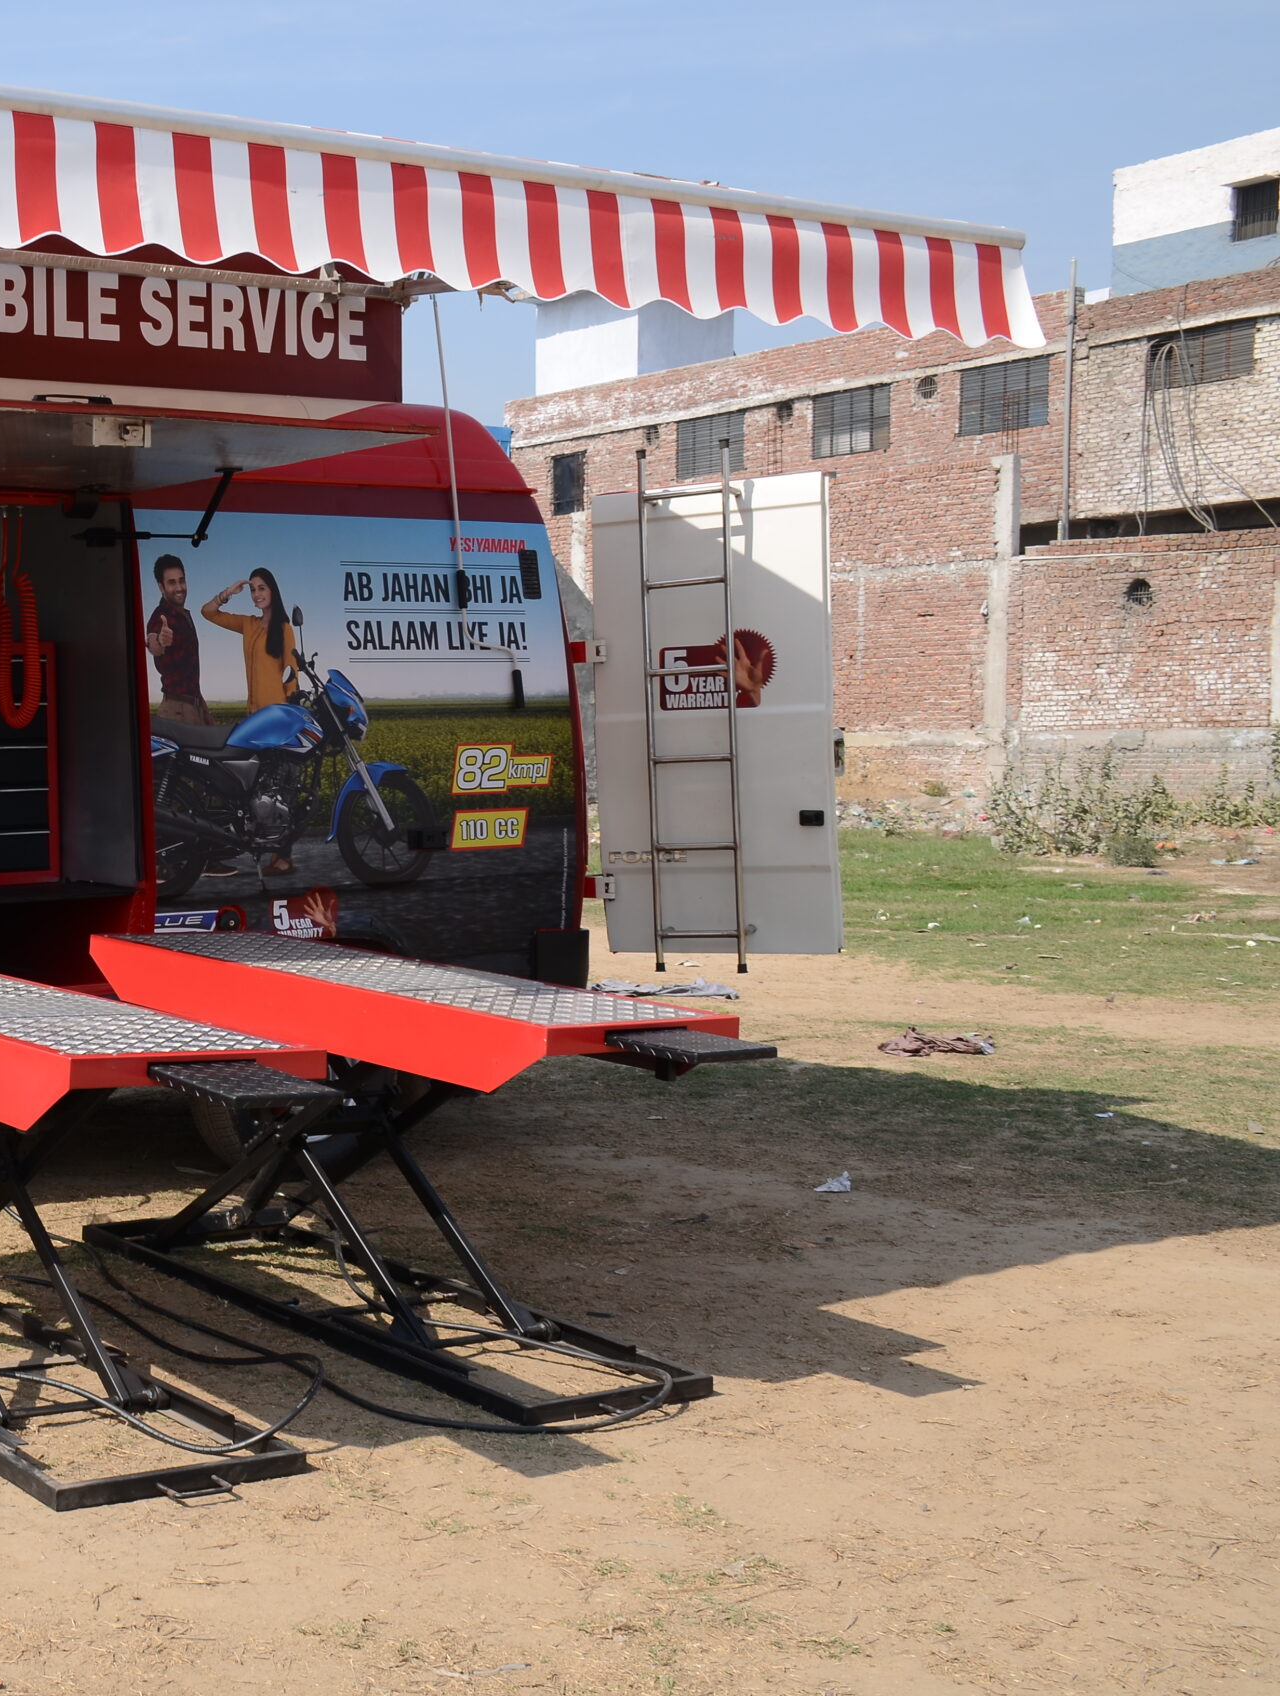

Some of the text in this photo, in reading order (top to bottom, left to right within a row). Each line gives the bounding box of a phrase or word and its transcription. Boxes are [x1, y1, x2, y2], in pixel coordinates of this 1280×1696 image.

[139, 277, 367, 361] SERVICE
[344, 572, 373, 602] AB
[382, 573, 450, 603] JAHAN
[500, 575, 523, 604] JA
[346, 620, 439, 651] SALAAM
[446, 621, 491, 651] LIYE
[664, 649, 725, 693] 5 YEAR
[665, 691, 738, 709] WARRANT
[457, 747, 549, 790] 82 kmpl
[460, 817, 519, 841] 110 CC
[273, 900, 313, 930] 5 YEAR
